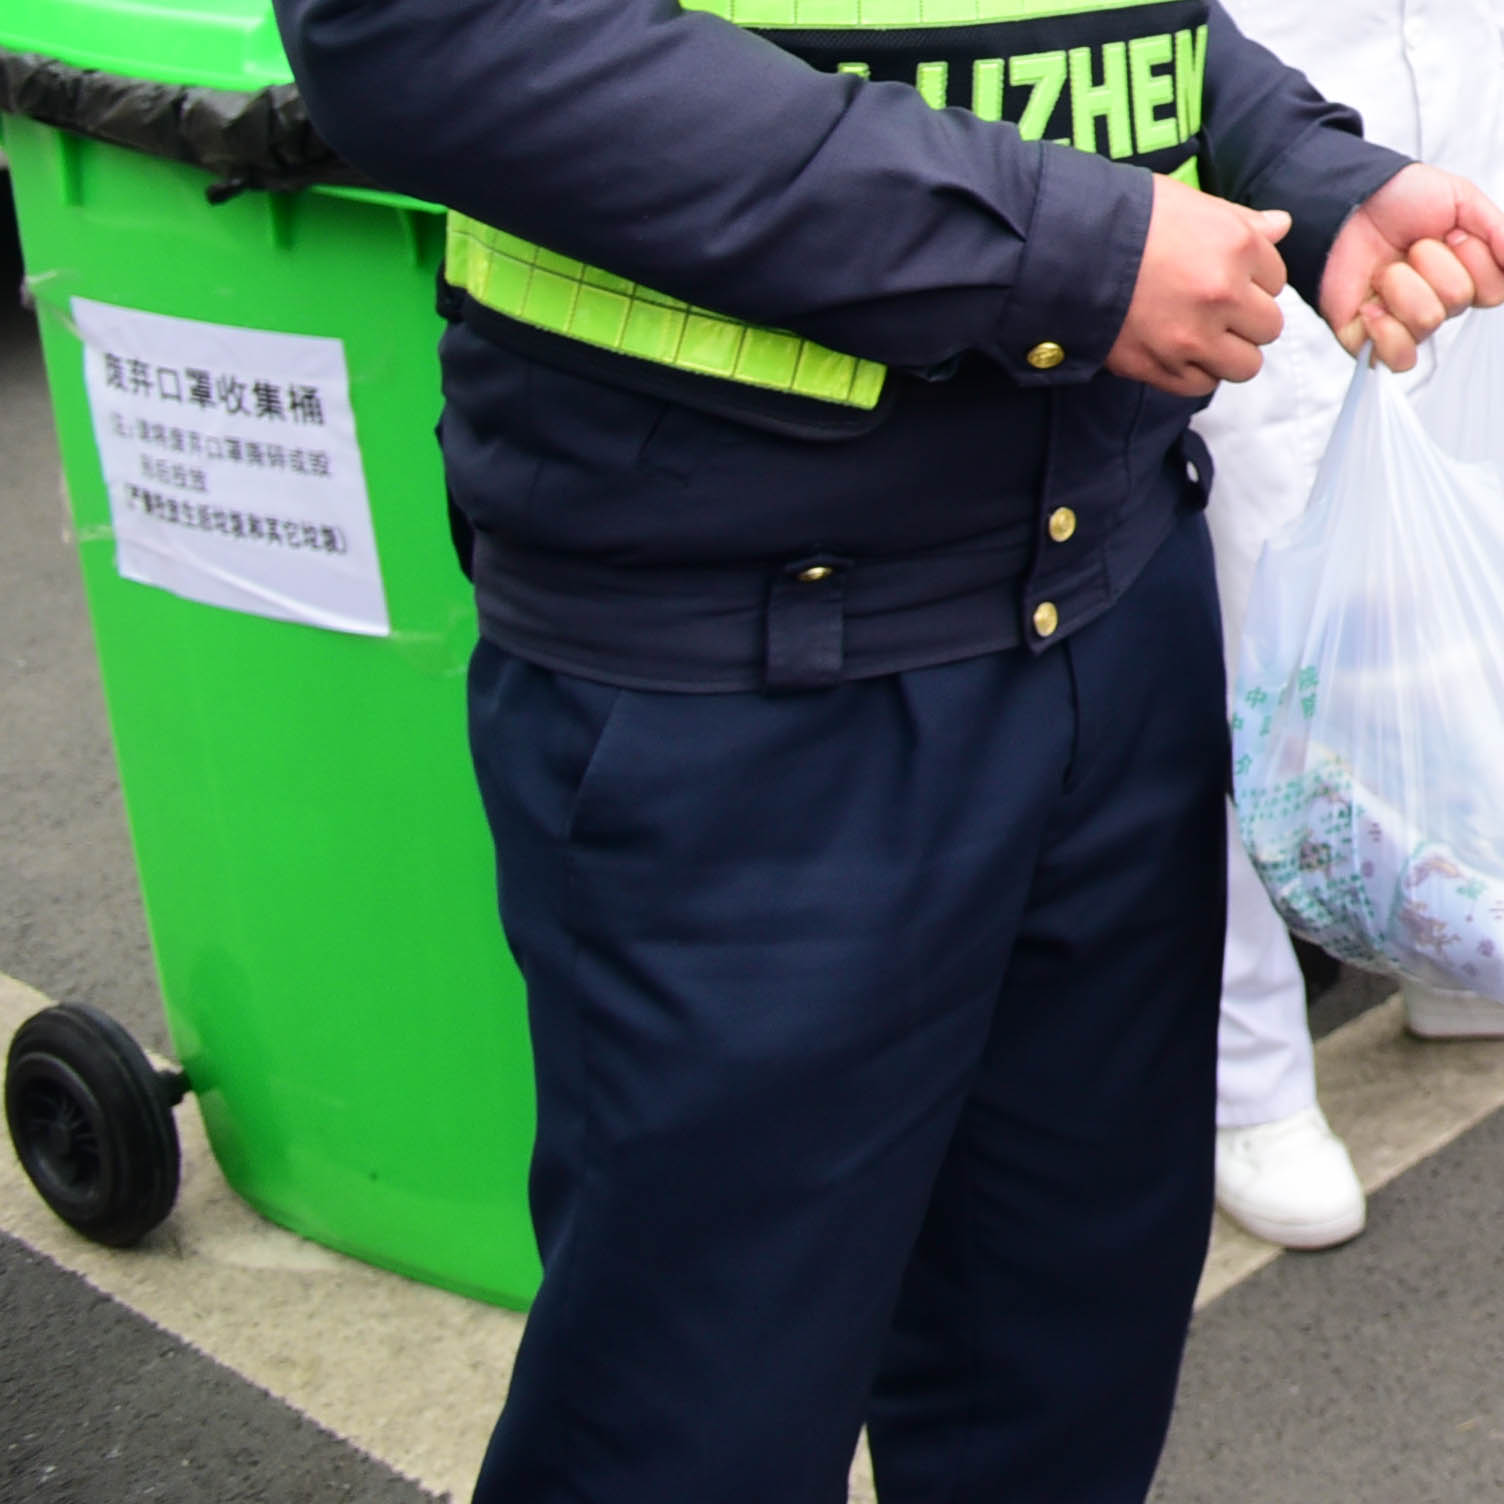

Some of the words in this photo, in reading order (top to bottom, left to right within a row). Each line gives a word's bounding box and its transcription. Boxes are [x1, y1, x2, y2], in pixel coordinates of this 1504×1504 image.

[103, 353, 326, 427] 废弃口罩收集桶
